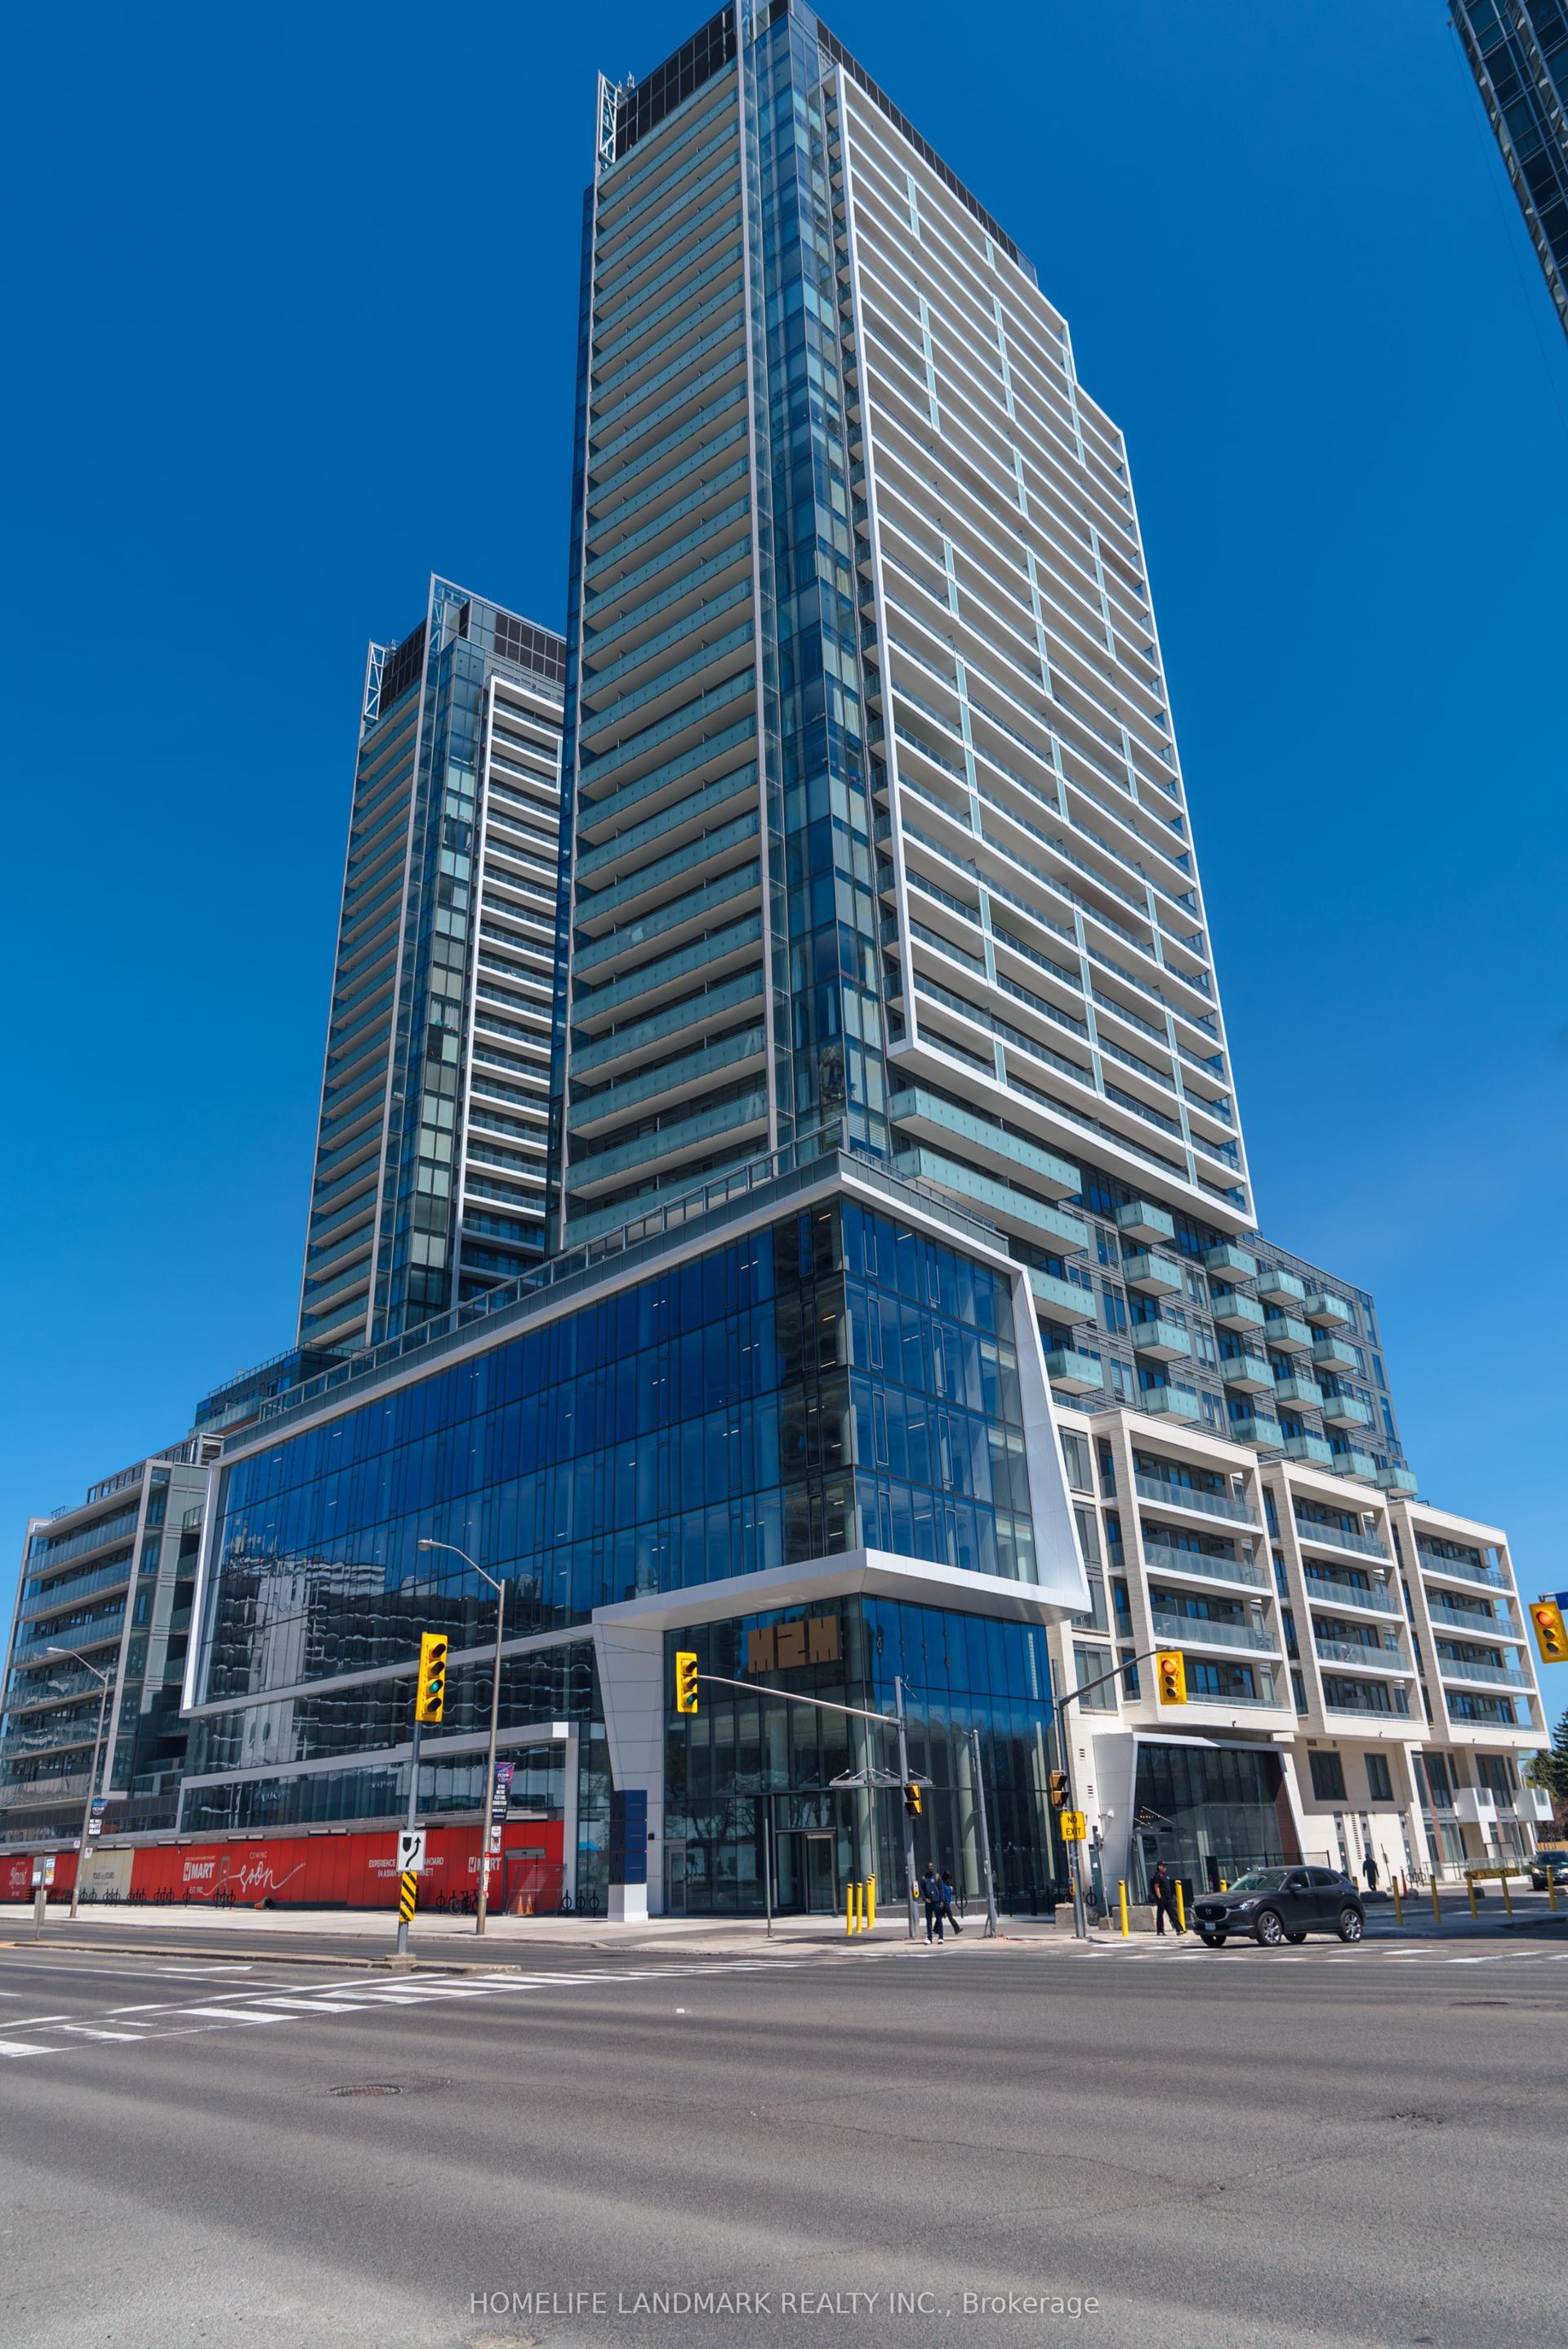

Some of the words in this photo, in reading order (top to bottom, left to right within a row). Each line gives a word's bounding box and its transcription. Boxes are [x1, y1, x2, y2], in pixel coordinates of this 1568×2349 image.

[1066, 1827, 1080, 1835] EXIT
[249, 1851, 267, 1859] COMING
[368, 1859, 396, 1868] EXPERIENCE
[423, 1856, 443, 1865] ANDARD
